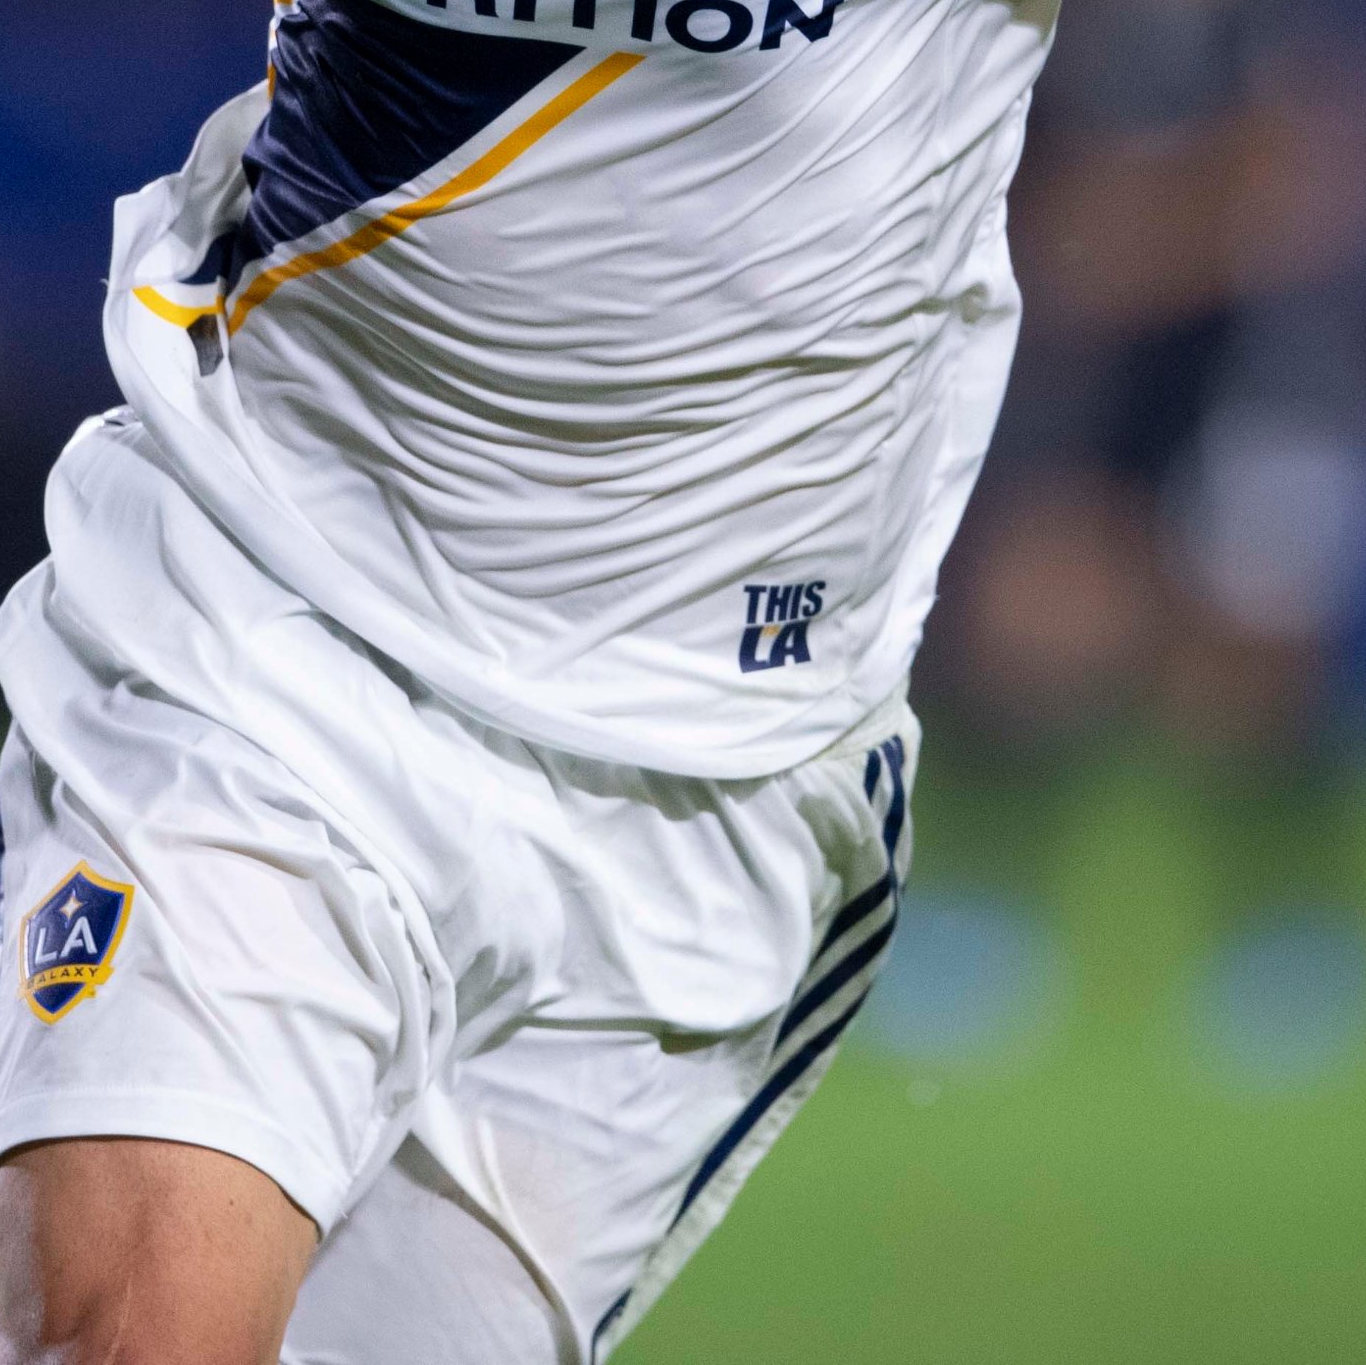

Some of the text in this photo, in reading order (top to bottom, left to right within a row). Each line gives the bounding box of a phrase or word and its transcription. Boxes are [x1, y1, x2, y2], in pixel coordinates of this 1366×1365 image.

[743, 580, 827, 624] THIS
[738, 619, 812, 674] LA
[34, 915, 99, 965] LA
